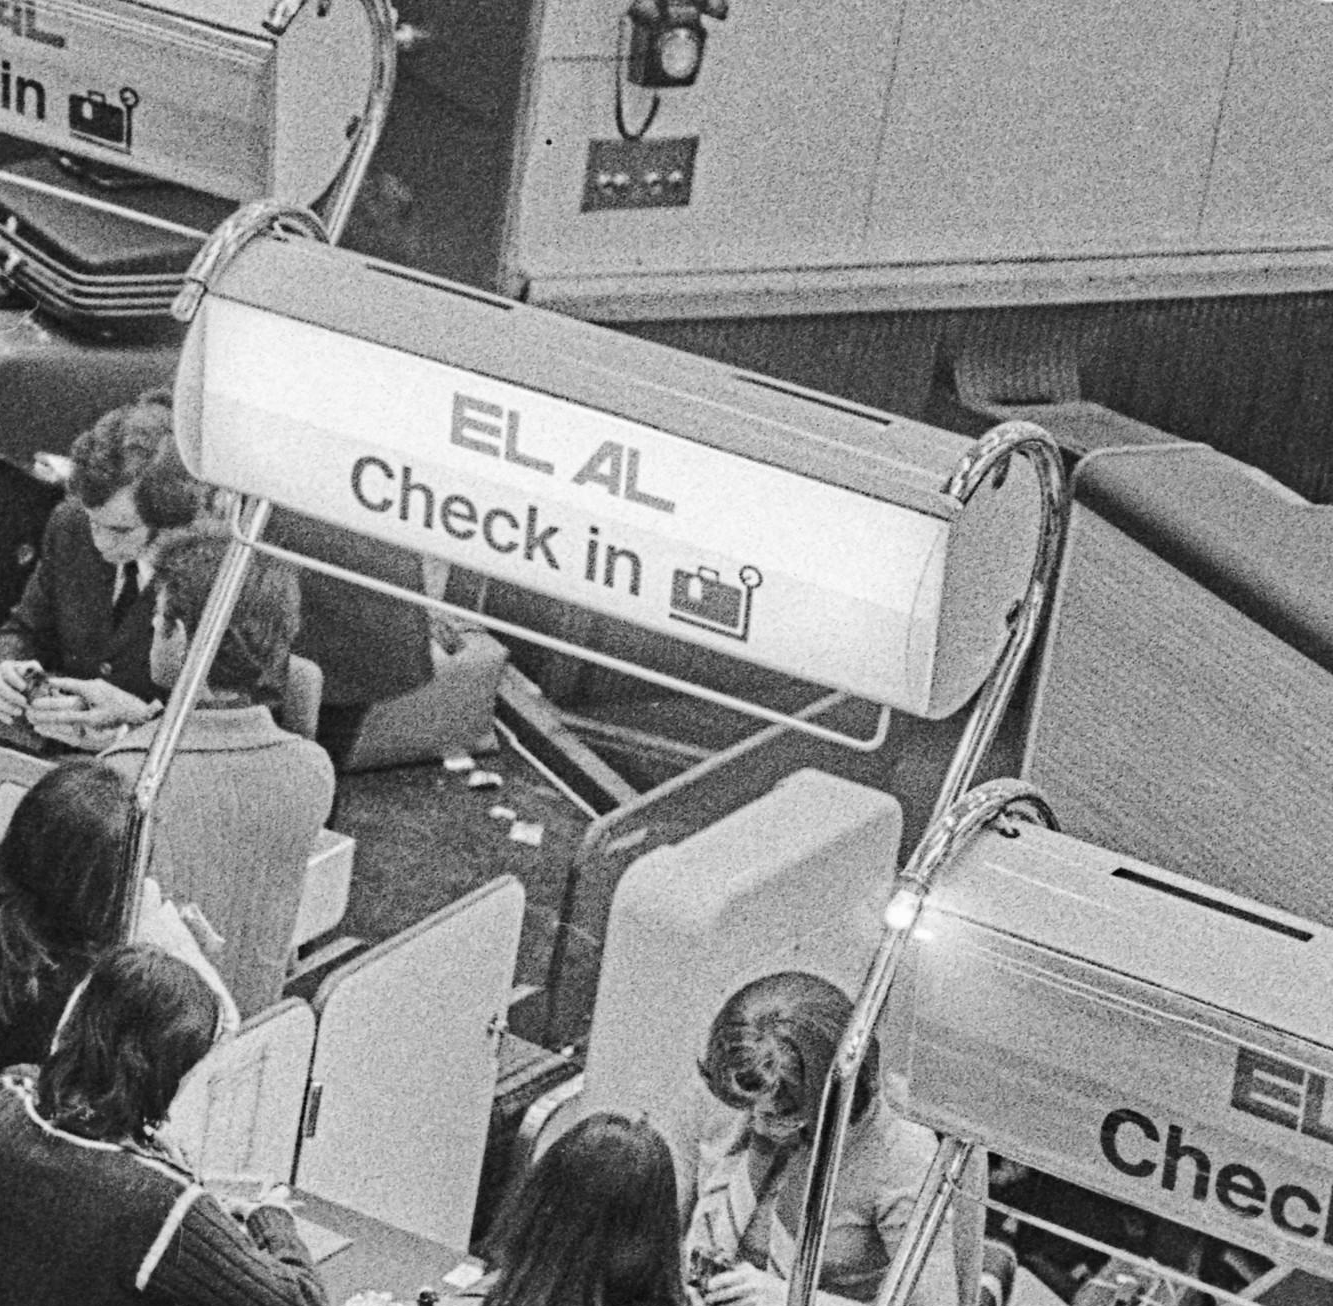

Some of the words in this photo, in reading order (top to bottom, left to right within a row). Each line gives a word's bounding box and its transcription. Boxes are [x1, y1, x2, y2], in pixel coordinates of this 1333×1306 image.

[1, 60, 46, 120] in
[450, 391, 555, 476] EL
[571, 440, 676, 515] AL
[350, 455, 561, 571] Check
[584, 525, 643, 597] in
[1099, 1107, 1333, 1246] Chec
